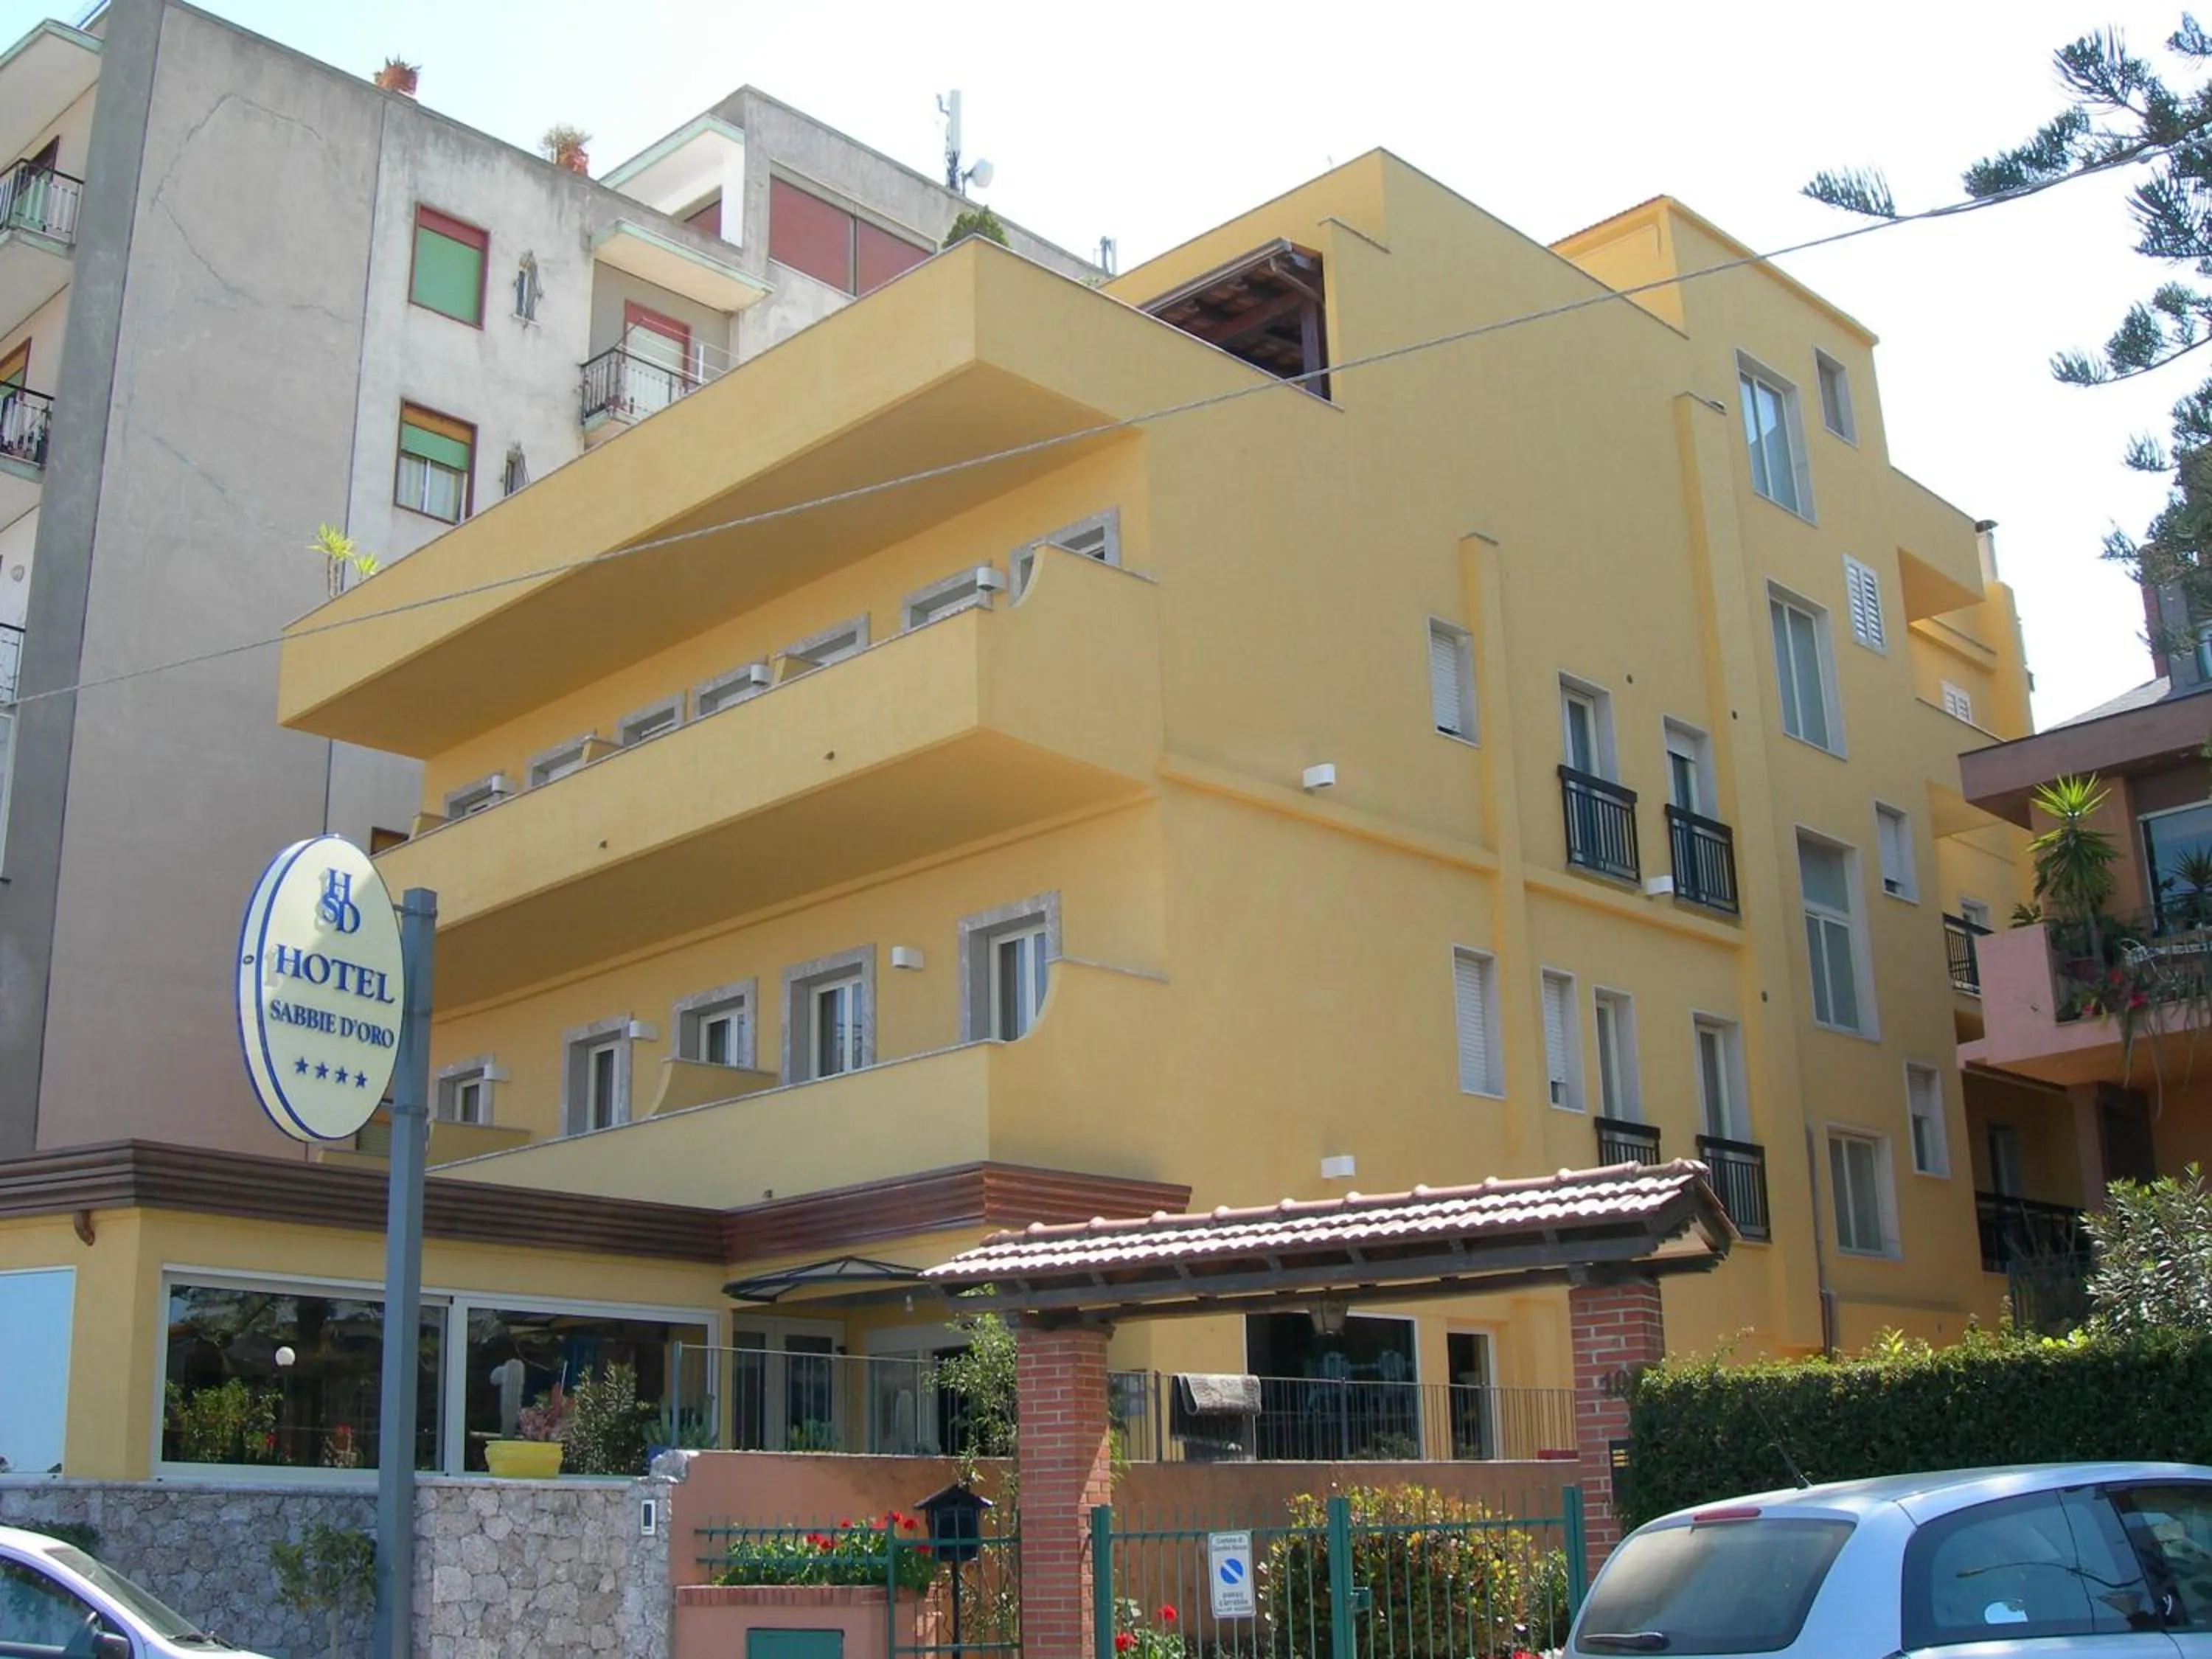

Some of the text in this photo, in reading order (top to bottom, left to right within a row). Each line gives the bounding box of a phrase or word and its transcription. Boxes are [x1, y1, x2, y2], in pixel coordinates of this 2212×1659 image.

[275, 944, 395, 1004] HOTEL
[270, 999, 394, 1048] SABBIE D'ORO
